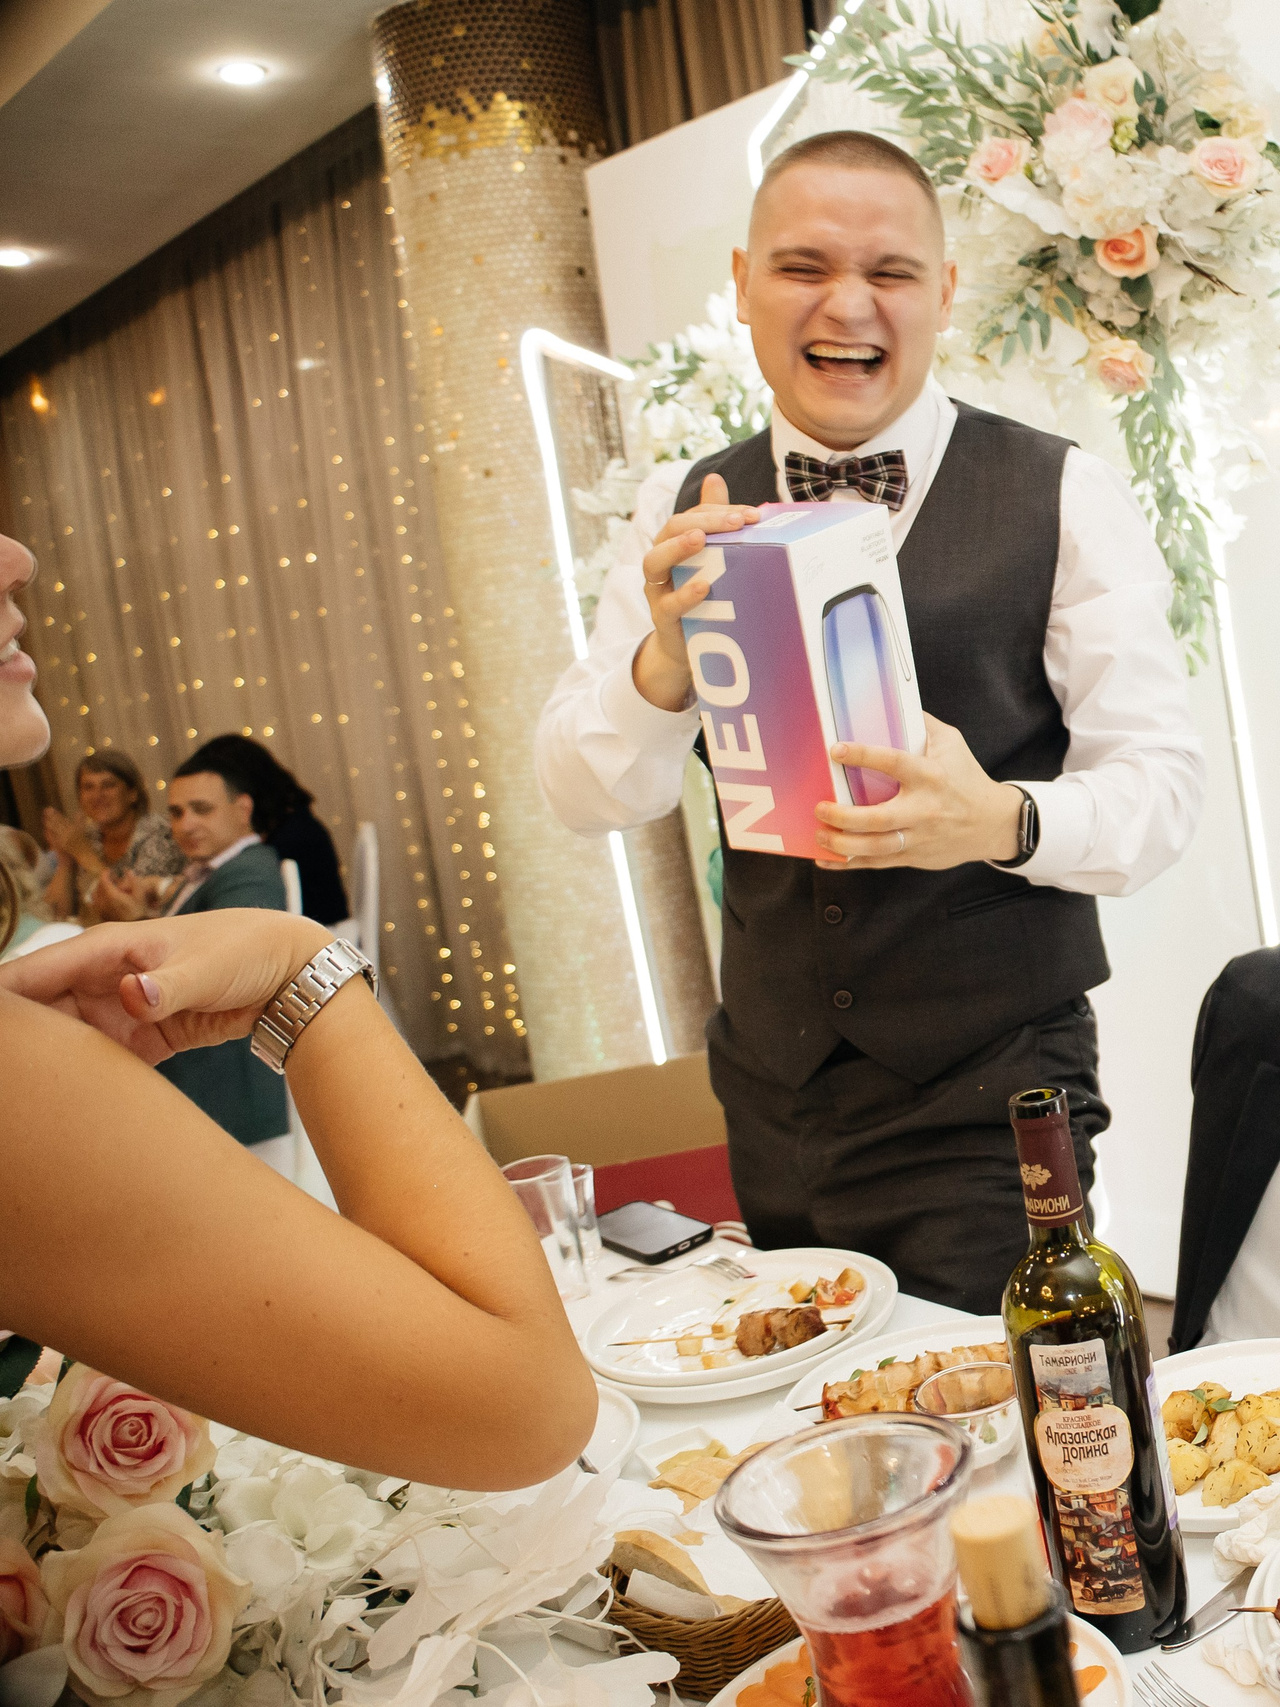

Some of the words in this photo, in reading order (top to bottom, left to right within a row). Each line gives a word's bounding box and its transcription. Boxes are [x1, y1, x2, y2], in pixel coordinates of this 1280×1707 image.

[676, 547, 785, 852] NEON
[1056, 1420, 1102, 1430] ПОЛУСЛАДКОЕ
[1062, 1415, 1092, 1423] КРАСНОЕ
[1045, 1425, 1118, 1447] Алазанская
